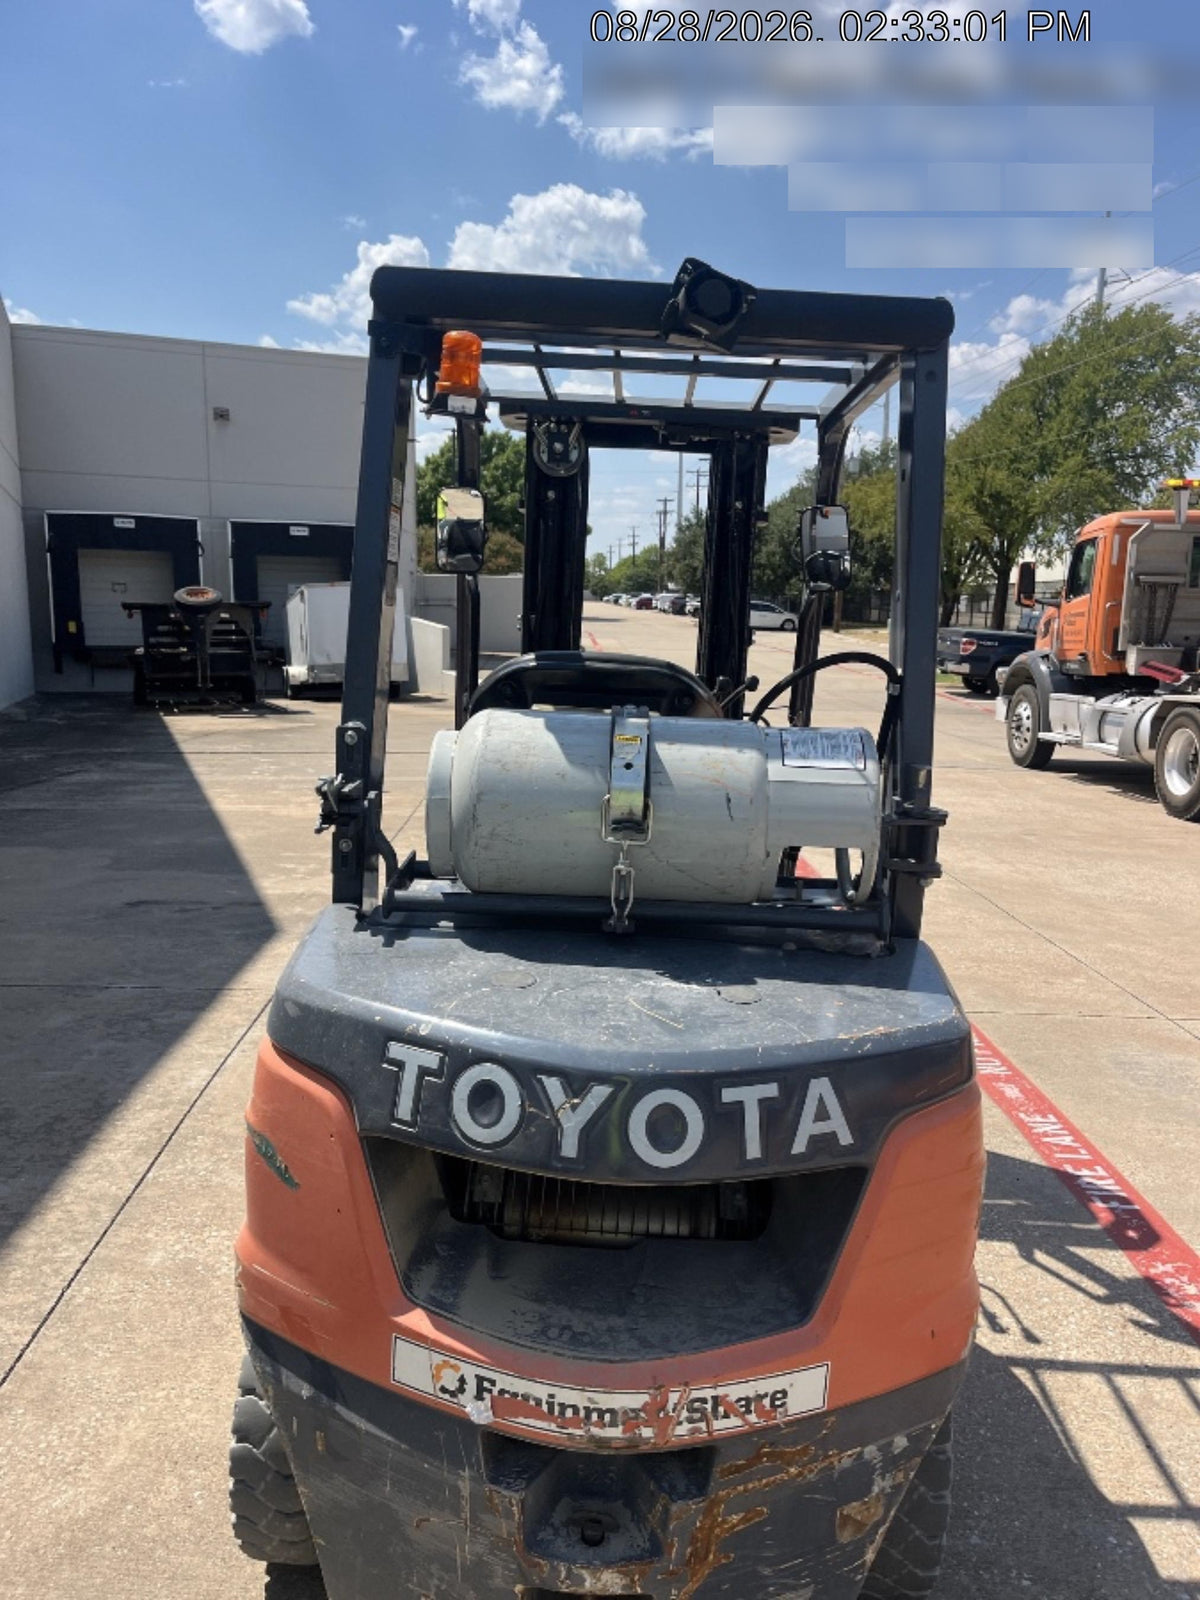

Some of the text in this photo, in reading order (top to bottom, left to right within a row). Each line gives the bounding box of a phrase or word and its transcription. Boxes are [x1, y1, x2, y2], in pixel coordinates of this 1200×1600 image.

[382, 1041, 854, 1168] TOYOTA
[1018, 1111, 1095, 1160] LANE
[1062, 1163, 1141, 1211] FIRE
